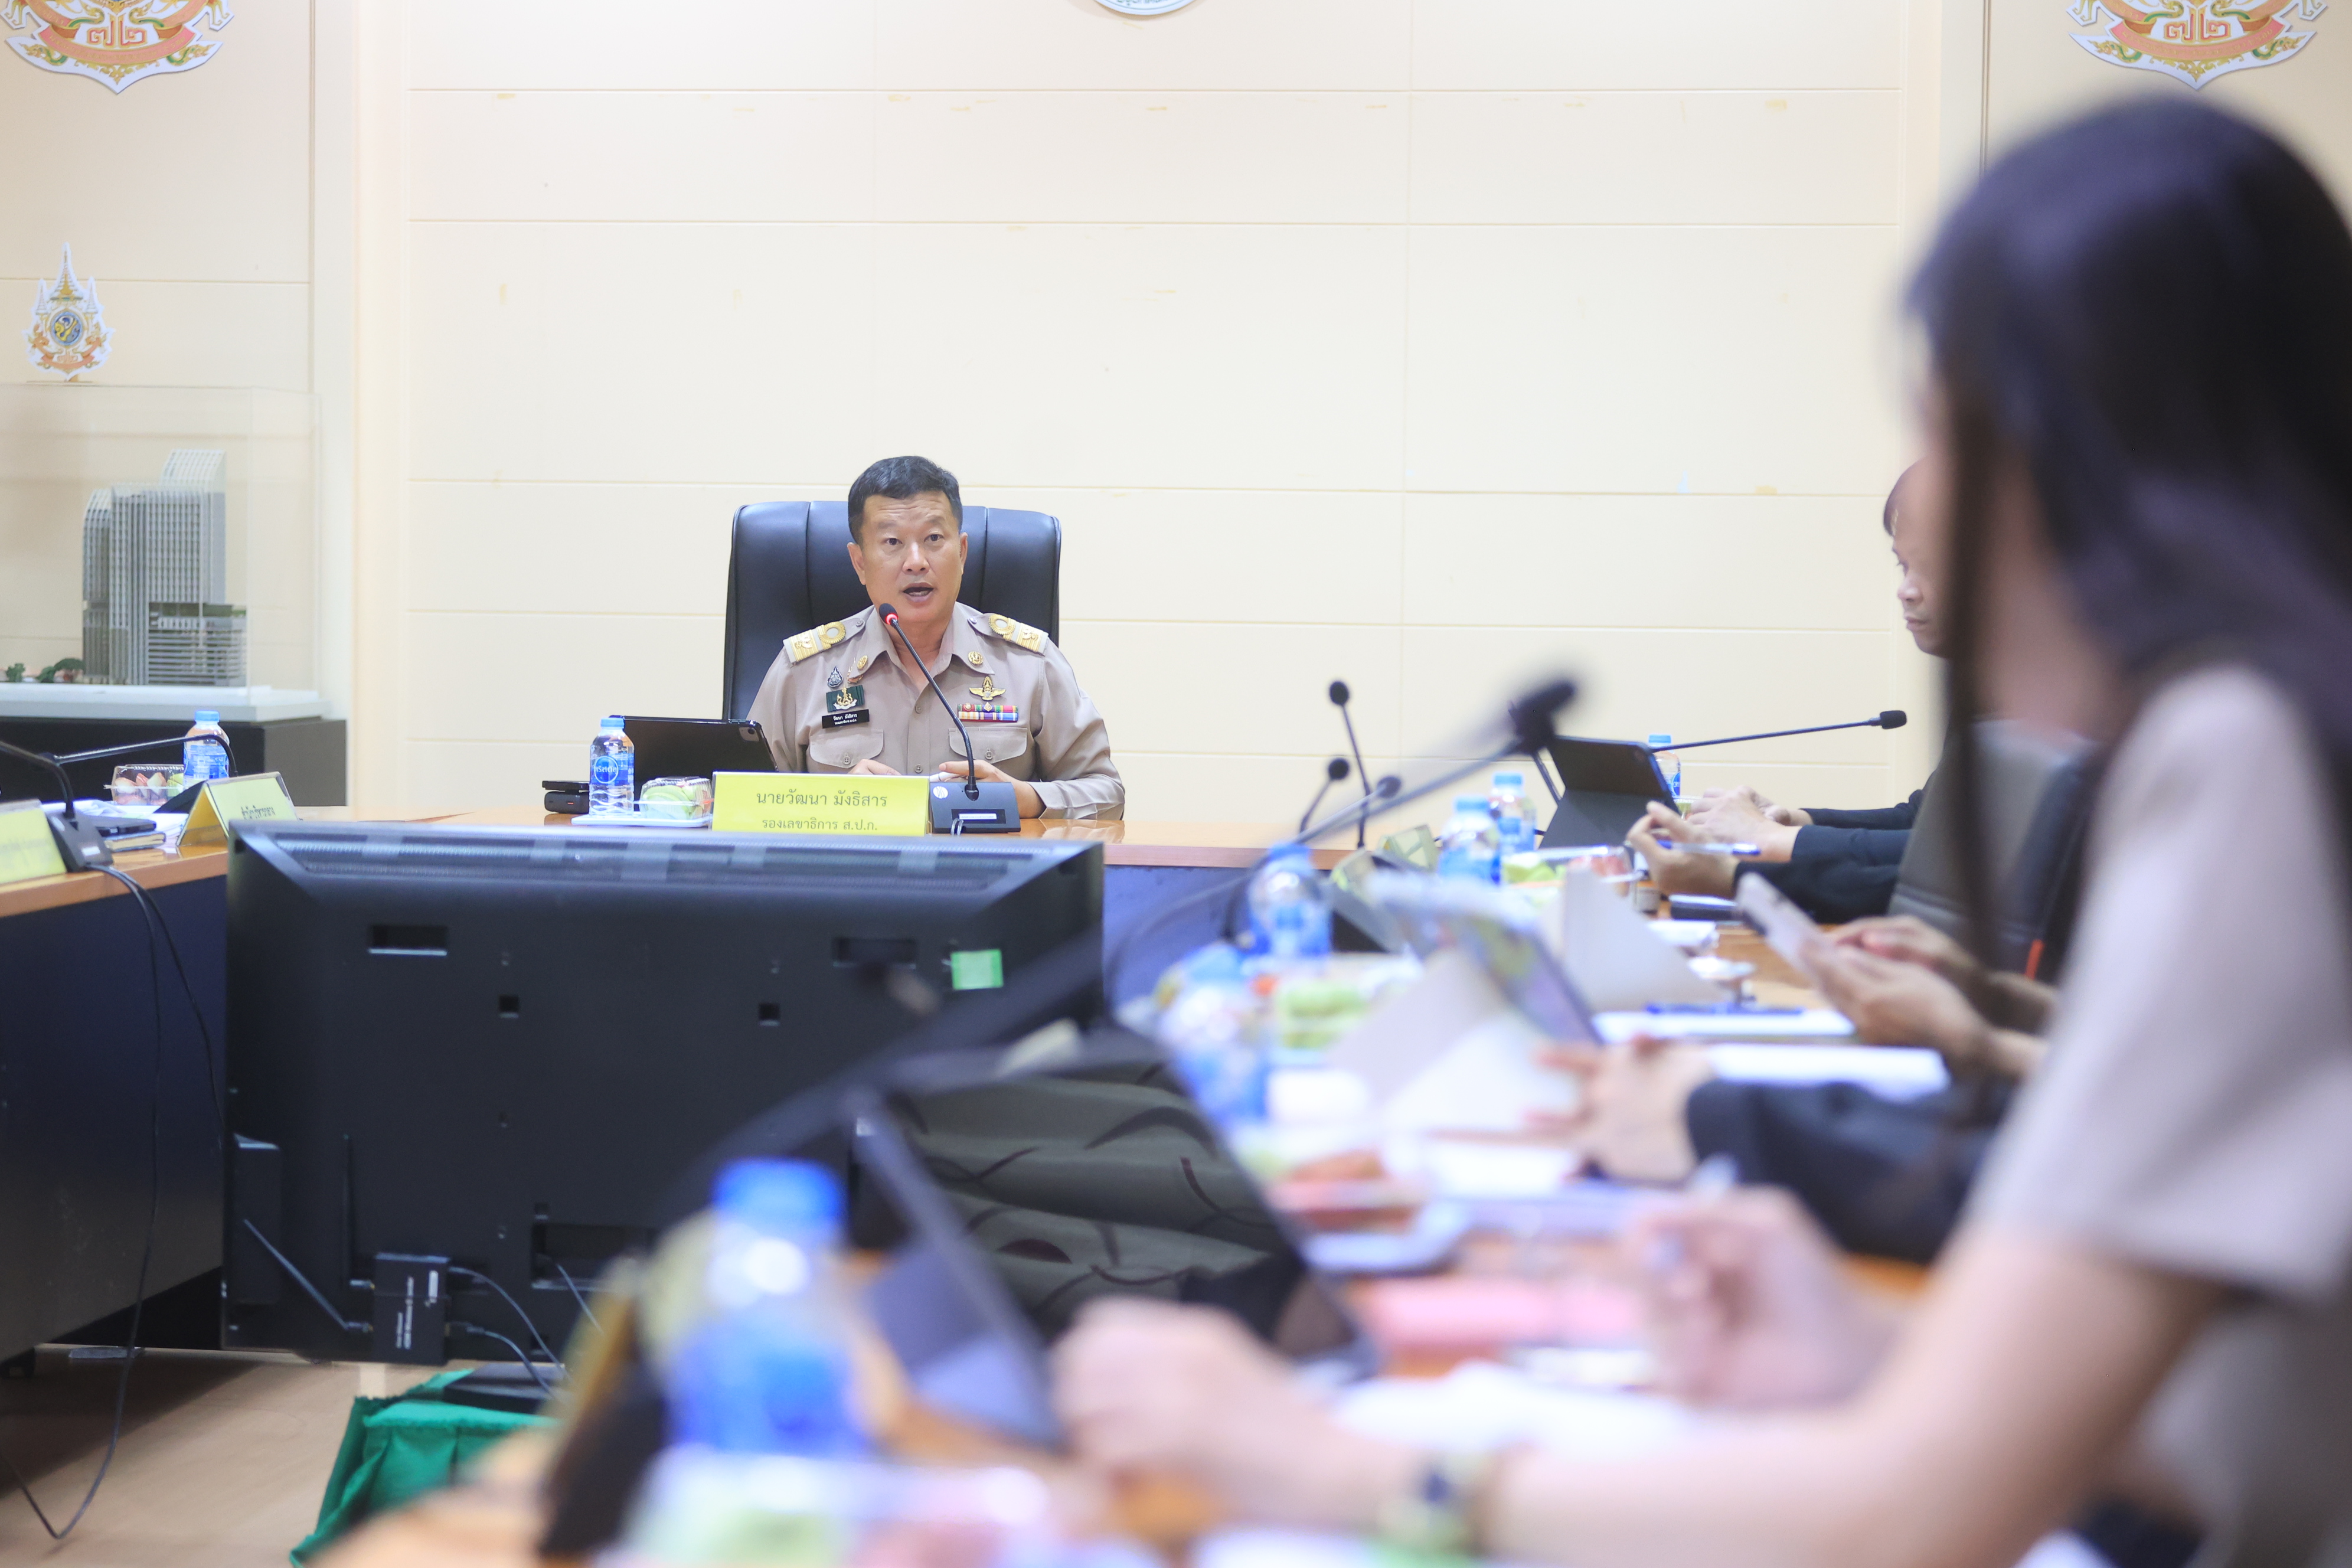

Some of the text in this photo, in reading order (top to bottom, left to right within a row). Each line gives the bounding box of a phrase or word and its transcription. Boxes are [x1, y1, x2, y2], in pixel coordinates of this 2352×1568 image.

[756, 789, 887, 807] นายวัฒนา มังธิสาร
[762, 817, 878, 831] รองเลขาธิการ ส.ป.ก.
